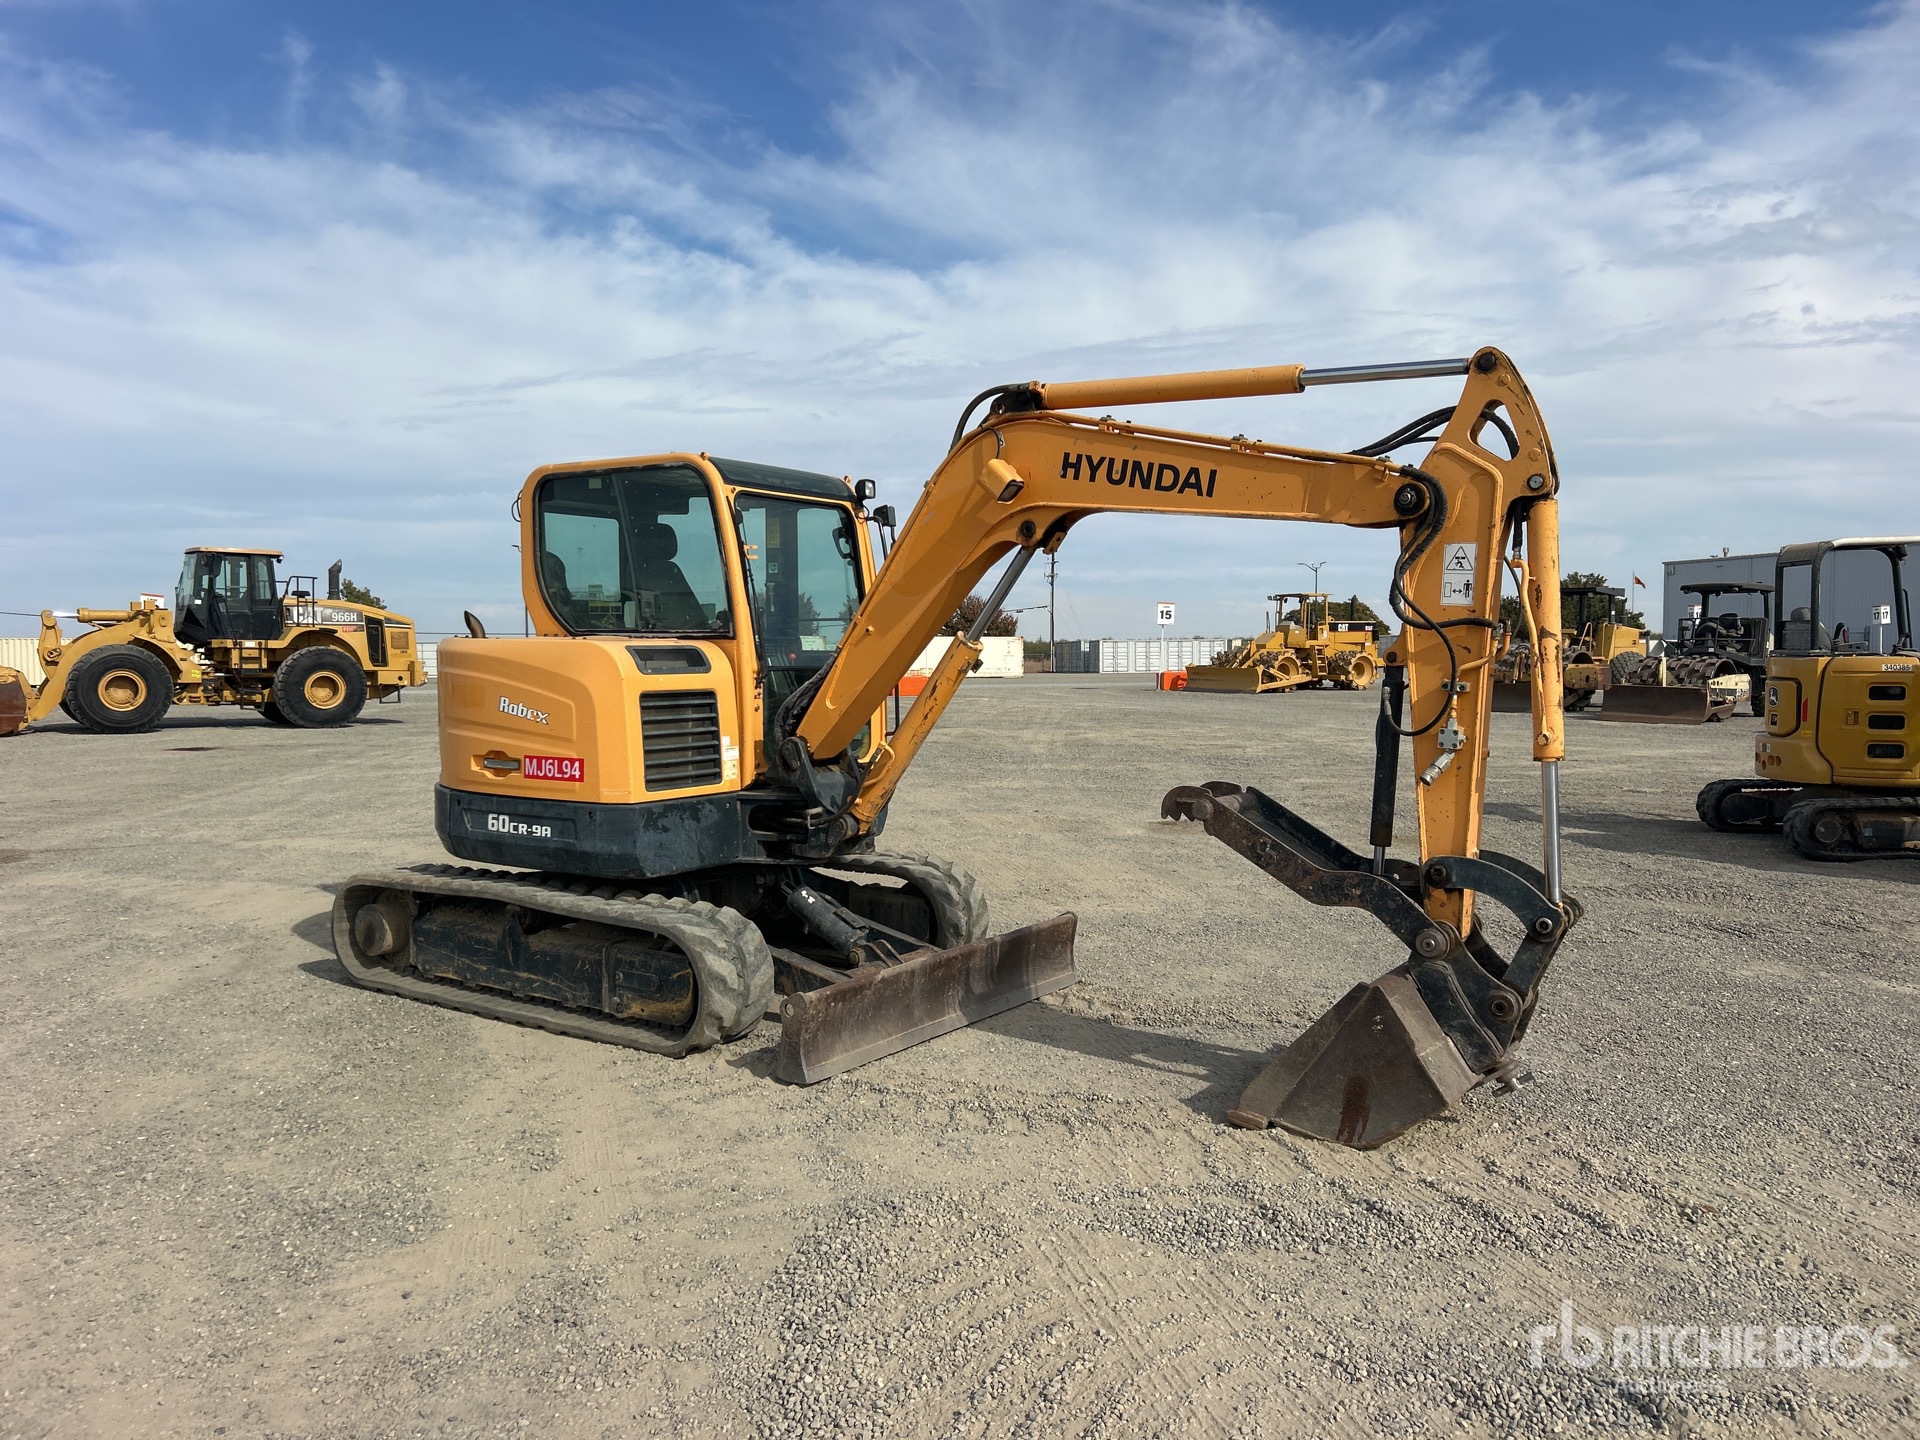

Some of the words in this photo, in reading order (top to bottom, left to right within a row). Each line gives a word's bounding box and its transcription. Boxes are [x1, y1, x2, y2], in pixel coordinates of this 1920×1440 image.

[1060, 452, 1218, 498] HYUNDAI
[331, 612, 357, 622] 966H
[1160, 610, 1172, 619] 15
[1873, 612, 1880, 620] 17
[1882, 611, 1888, 619] 17
[525, 757, 581, 779] MJ6L94
[487, 813, 552, 838] 60CR-9A
